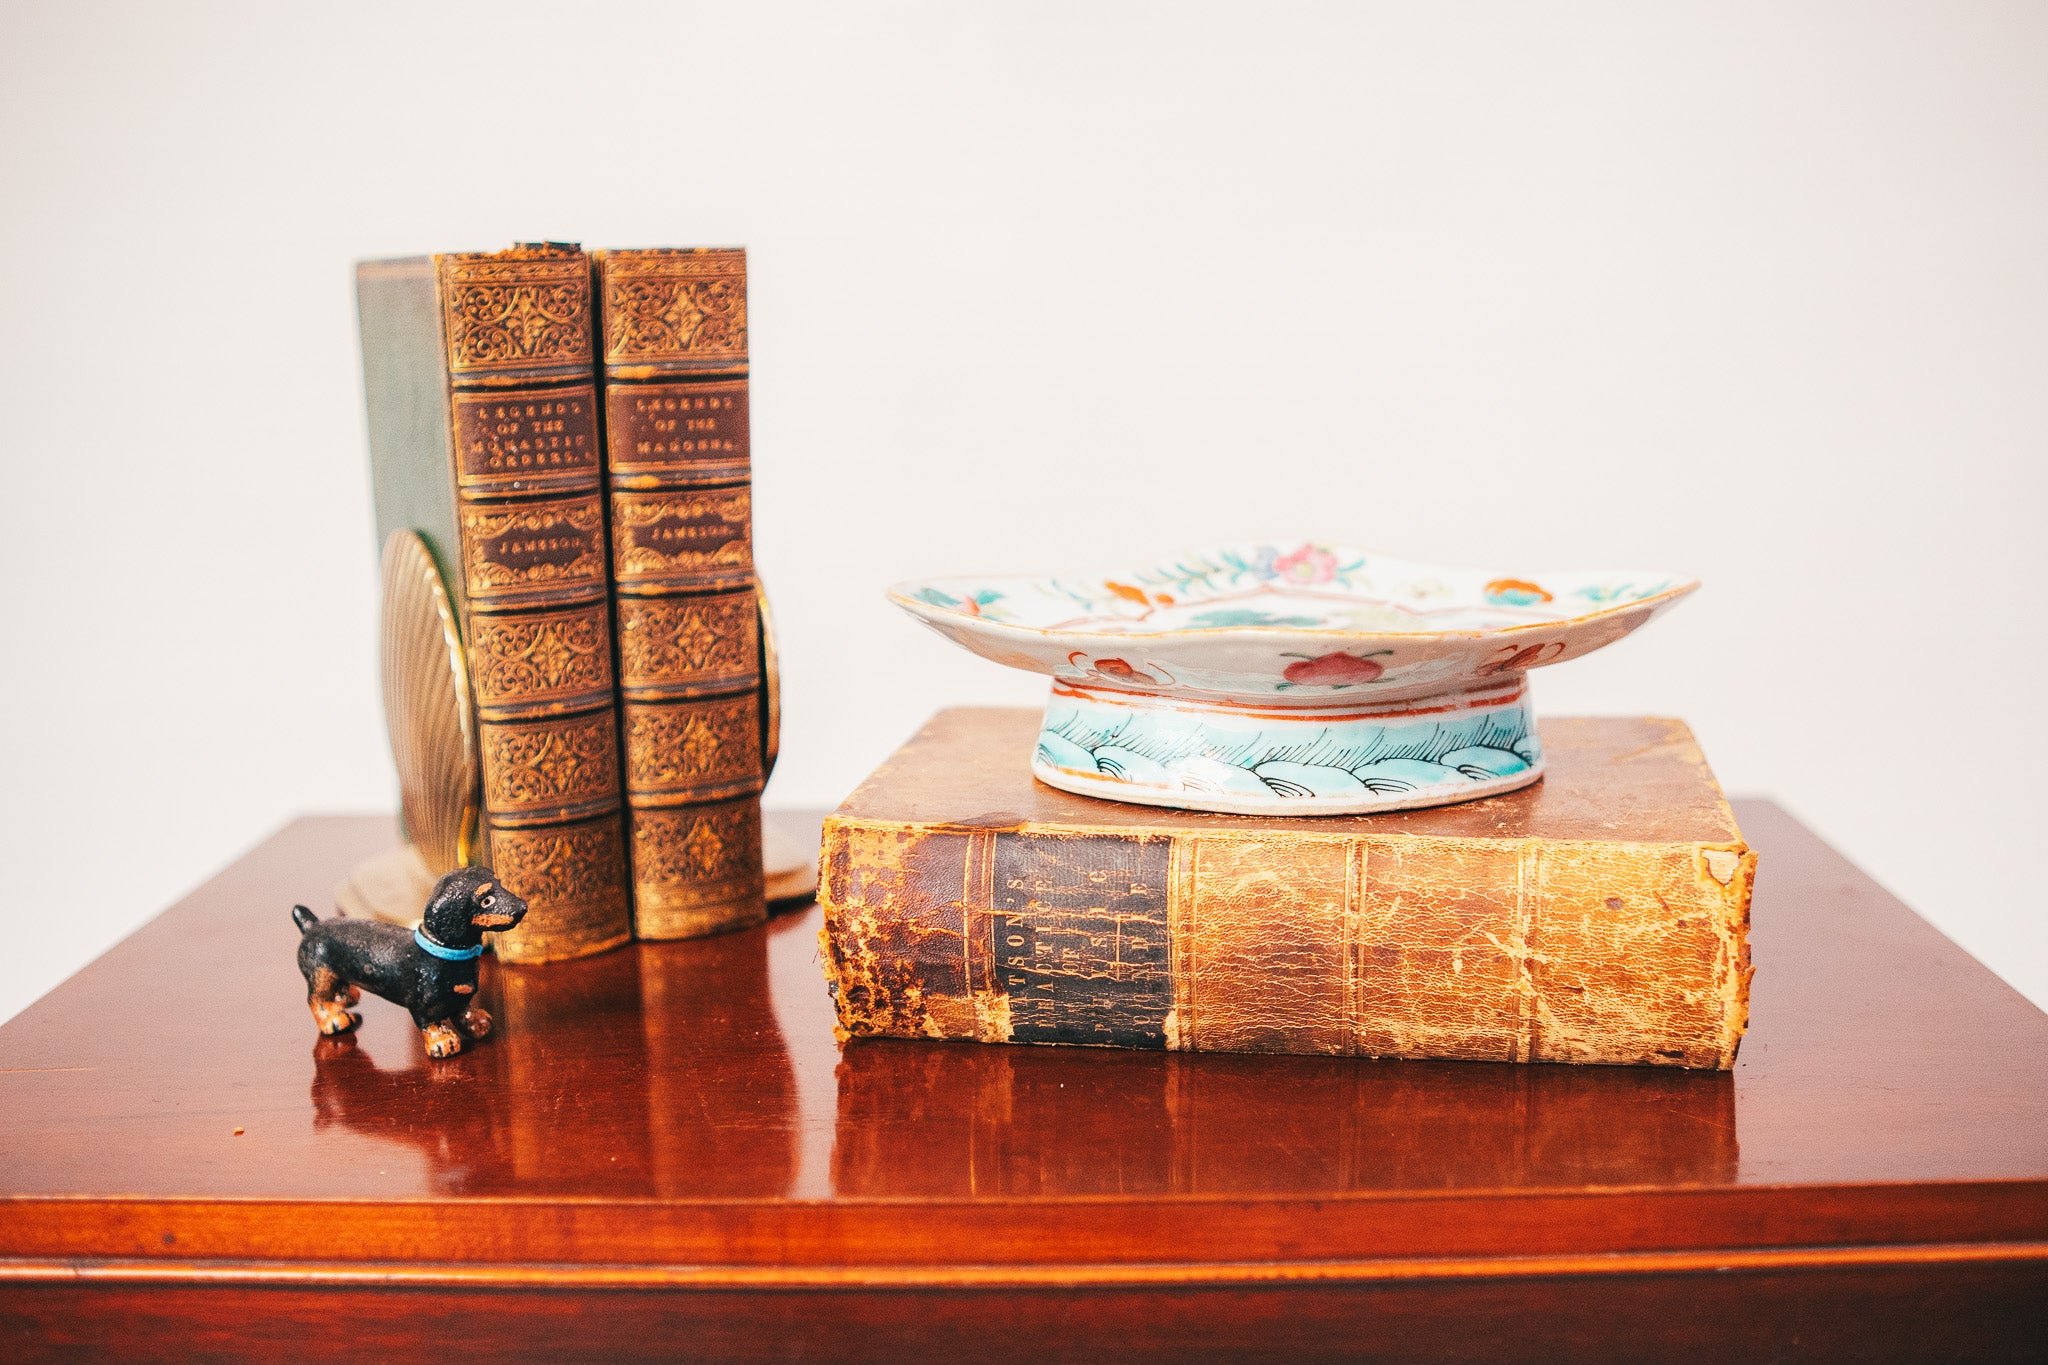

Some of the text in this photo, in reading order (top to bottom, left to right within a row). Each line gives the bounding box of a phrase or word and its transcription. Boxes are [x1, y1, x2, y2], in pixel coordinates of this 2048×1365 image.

[496, 419, 564, 435] OF THE
[654, 417, 716, 433] OF THE
